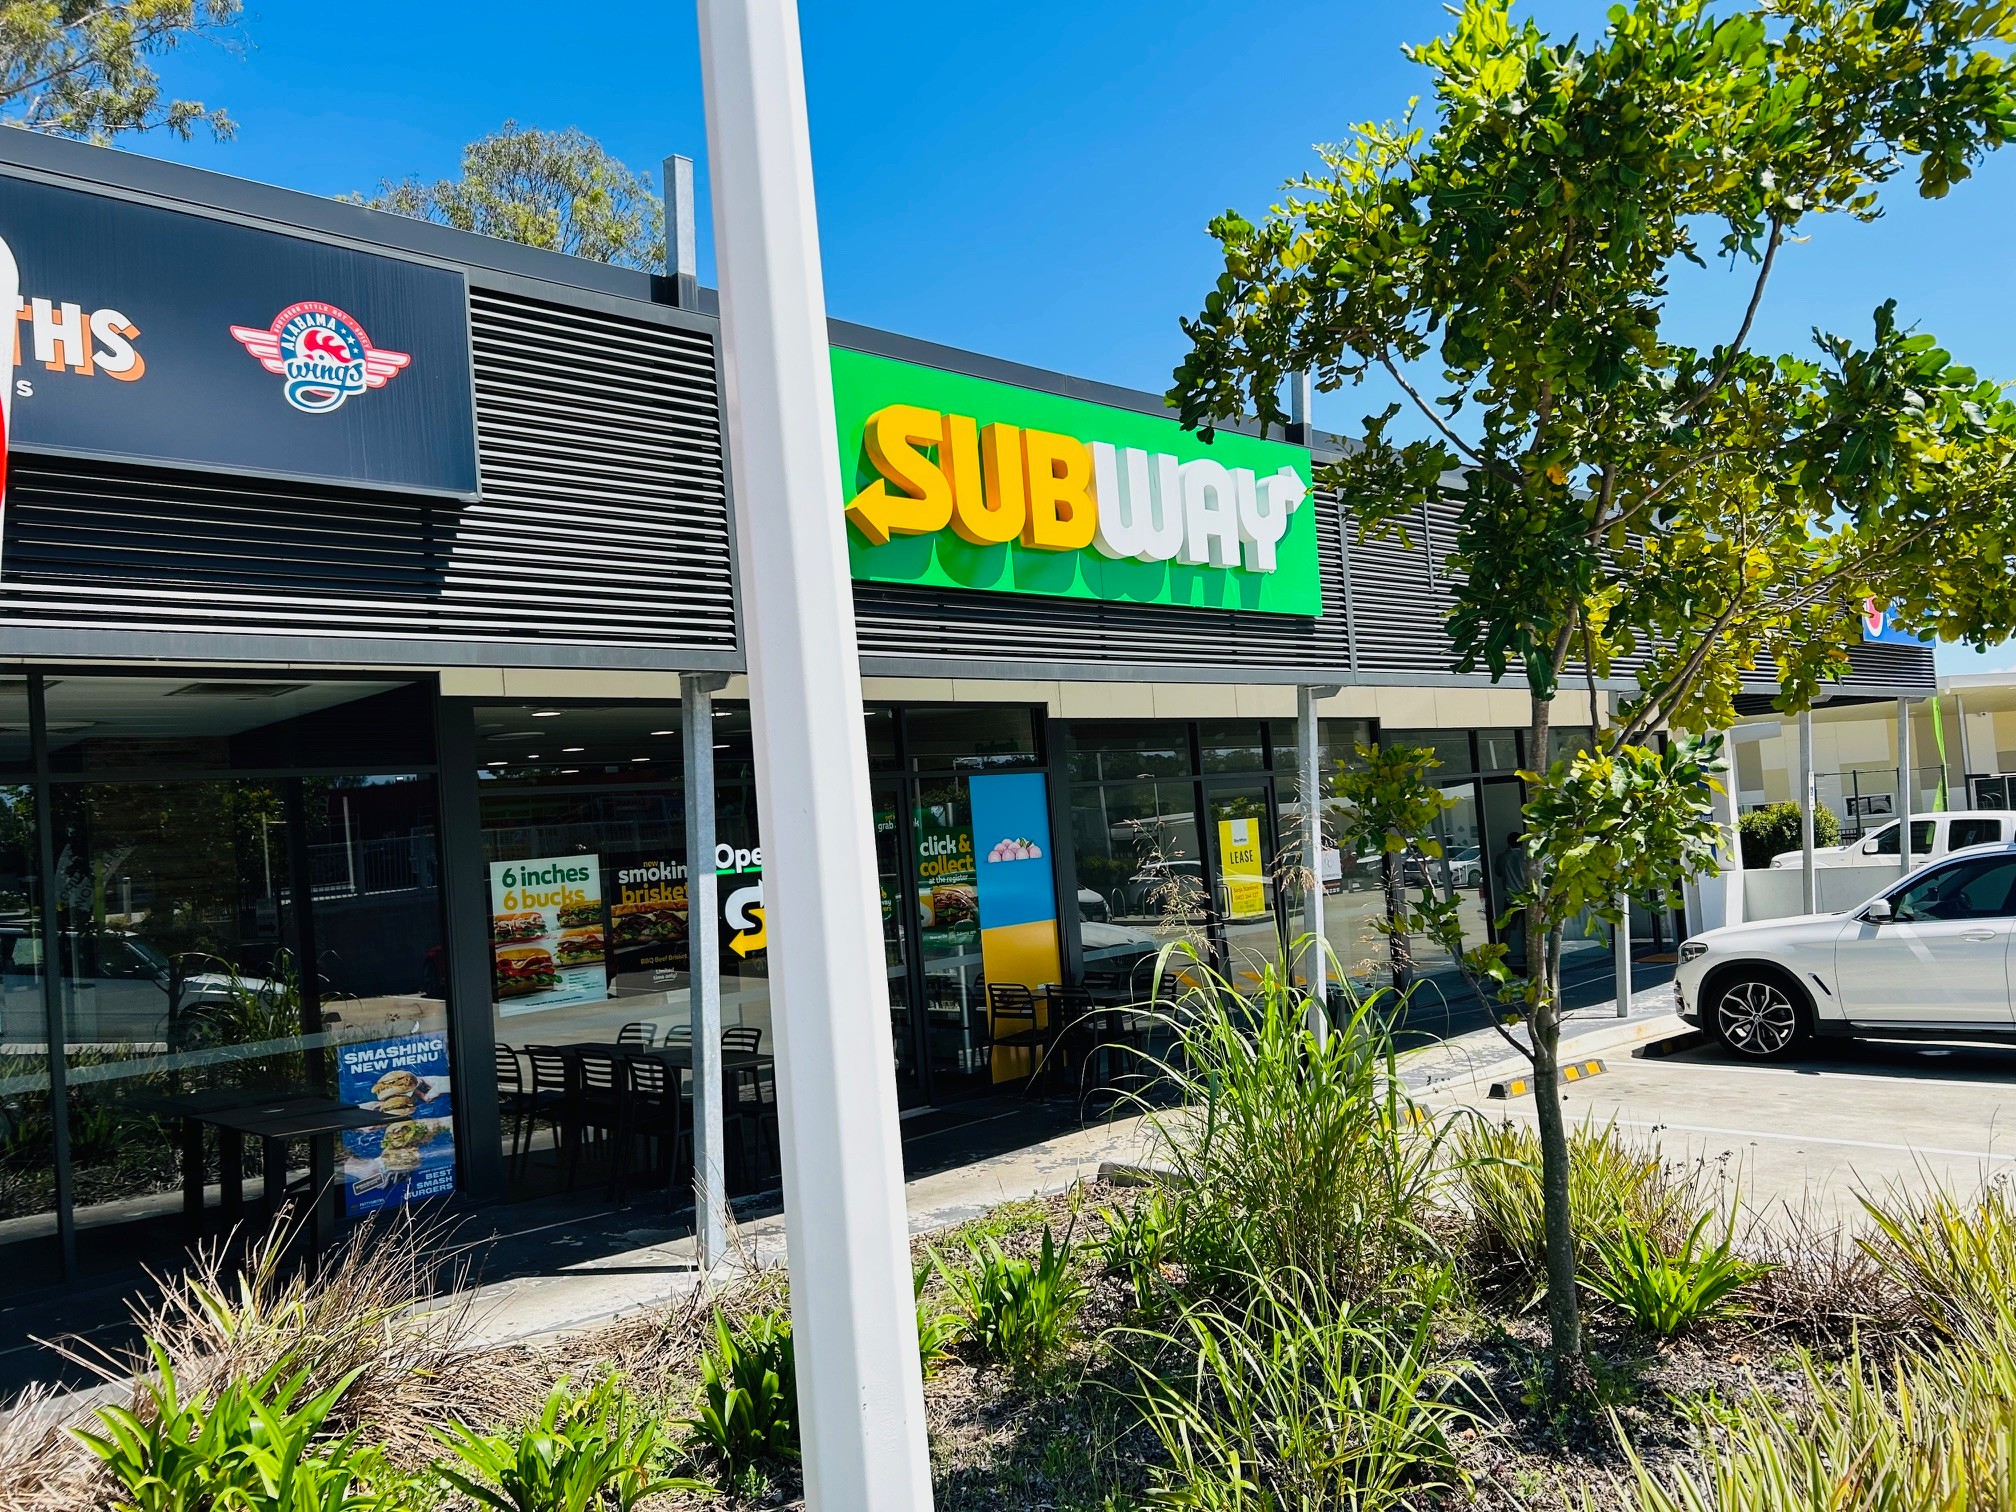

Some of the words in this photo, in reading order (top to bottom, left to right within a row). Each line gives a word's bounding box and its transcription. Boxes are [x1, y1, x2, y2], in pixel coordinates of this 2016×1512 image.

[17, 294, 145, 381] HS
[281, 313, 336, 350] ALABAMA
[287, 361, 364, 409] wings
[845, 403, 1309, 574] SUBWAY
[920, 834, 957, 857] click
[958, 833, 971, 853] &
[1230, 849, 1254, 864] LEASE
[502, 867, 517, 888] 6
[520, 863, 590, 887] inches
[643, 860, 659, 868] new
[920, 854, 975, 877] collect
[503, 889, 518, 911] 6
[522, 886, 586, 909] bucks
[344, 1039, 443, 1065] SMASHING
[351, 1059, 389, 1075] NEW
[392, 1051, 439, 1069] MENU
[416, 1176, 453, 1189] SMASH
[425, 1168, 453, 1180] BEST
